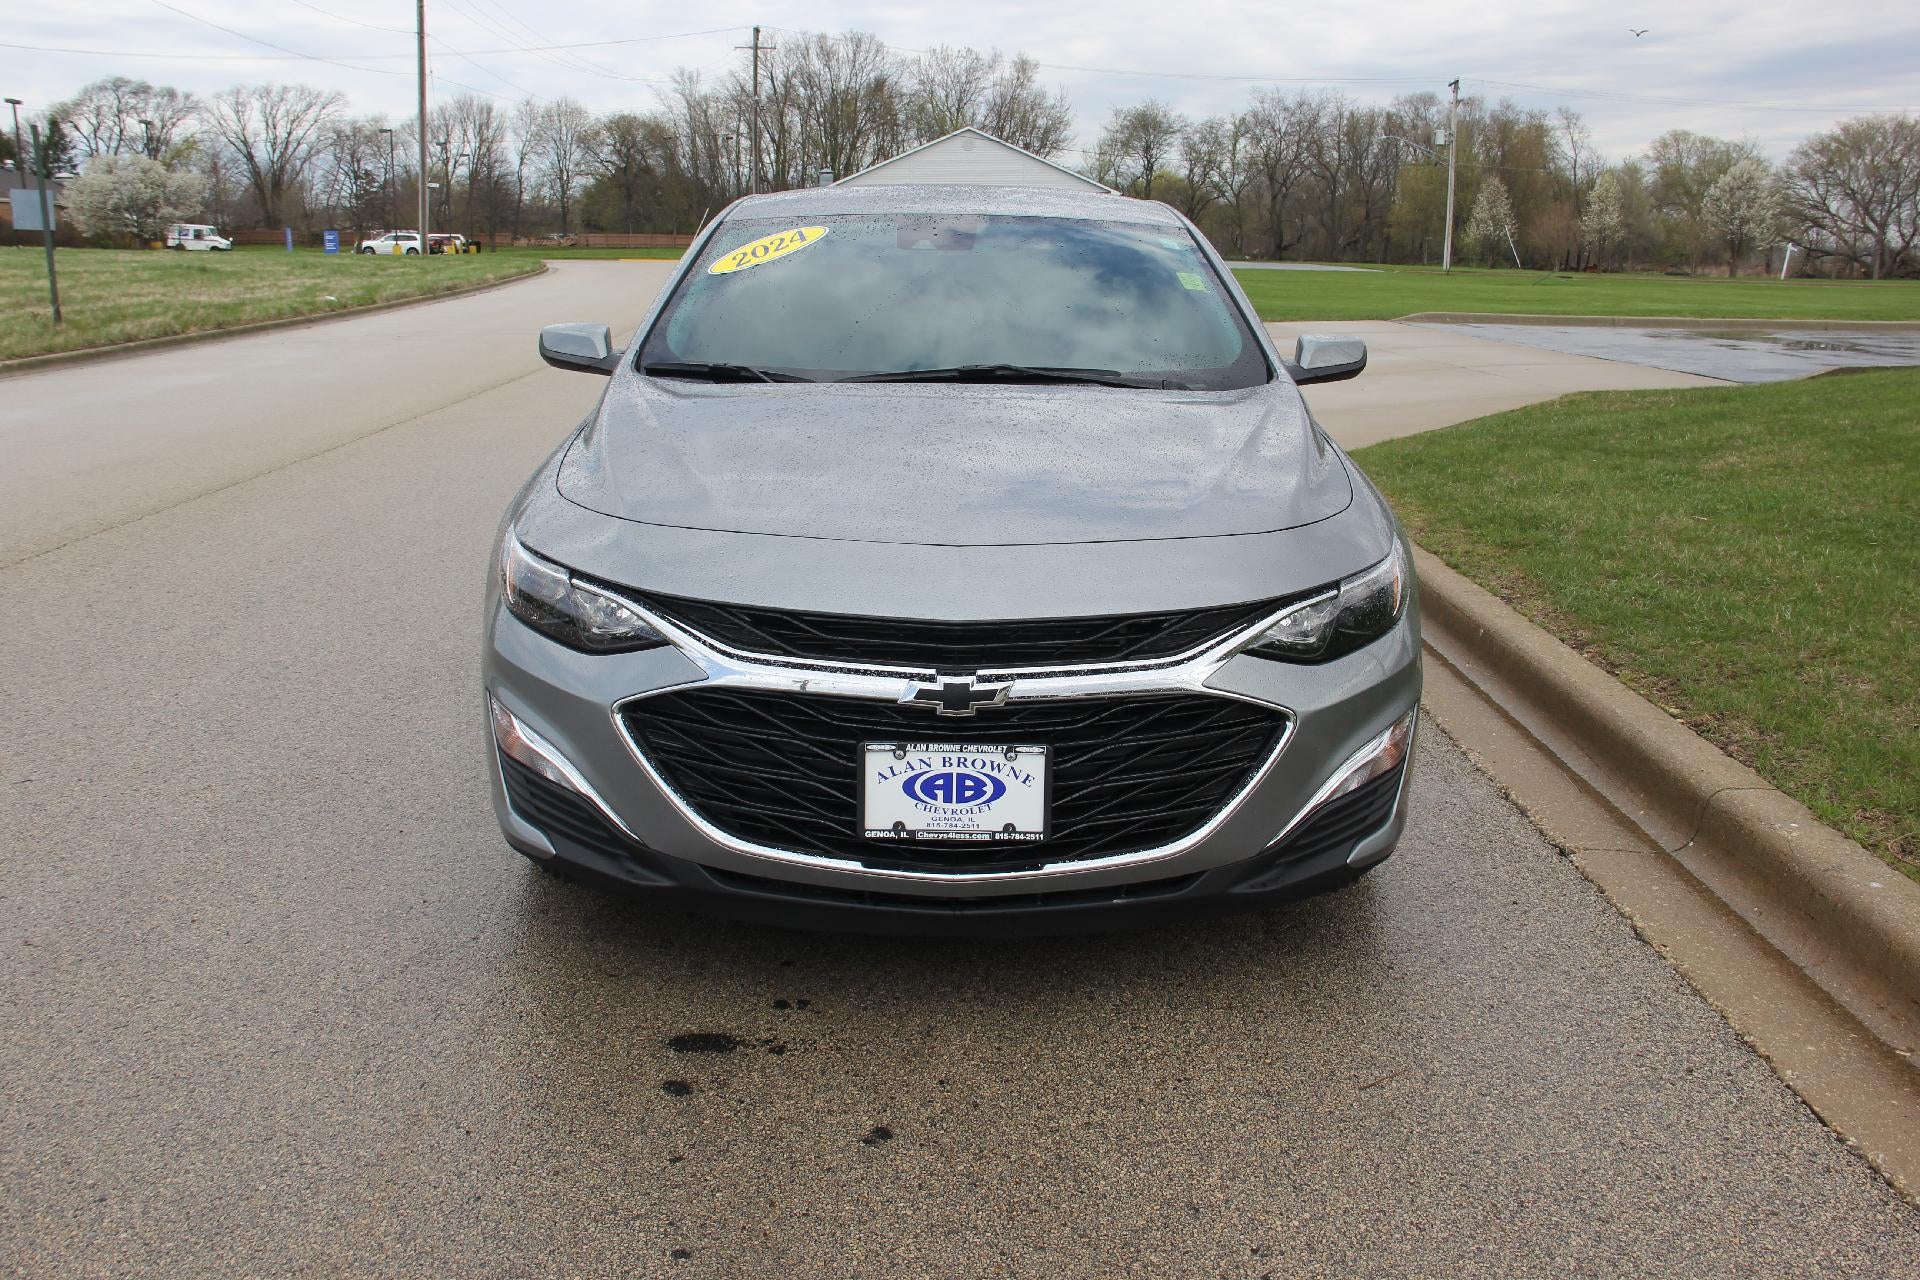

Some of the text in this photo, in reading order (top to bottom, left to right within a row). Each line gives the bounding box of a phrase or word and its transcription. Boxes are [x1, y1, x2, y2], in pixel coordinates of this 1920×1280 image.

[732, 230, 806, 268] 2024
[928, 744, 960, 752] BROWNE
[963, 745, 1007, 753] CHEVROLET
[876, 756, 1036, 788] ALAN BROWNE
[919, 772, 989, 804] AB
[914, 802, 993, 816] CHEVROLET
[865, 830, 897, 839] GENOA,
[917, 832, 990, 840] Chevys4less.com
[994, 832, 1044, 840] 815-784-2511
